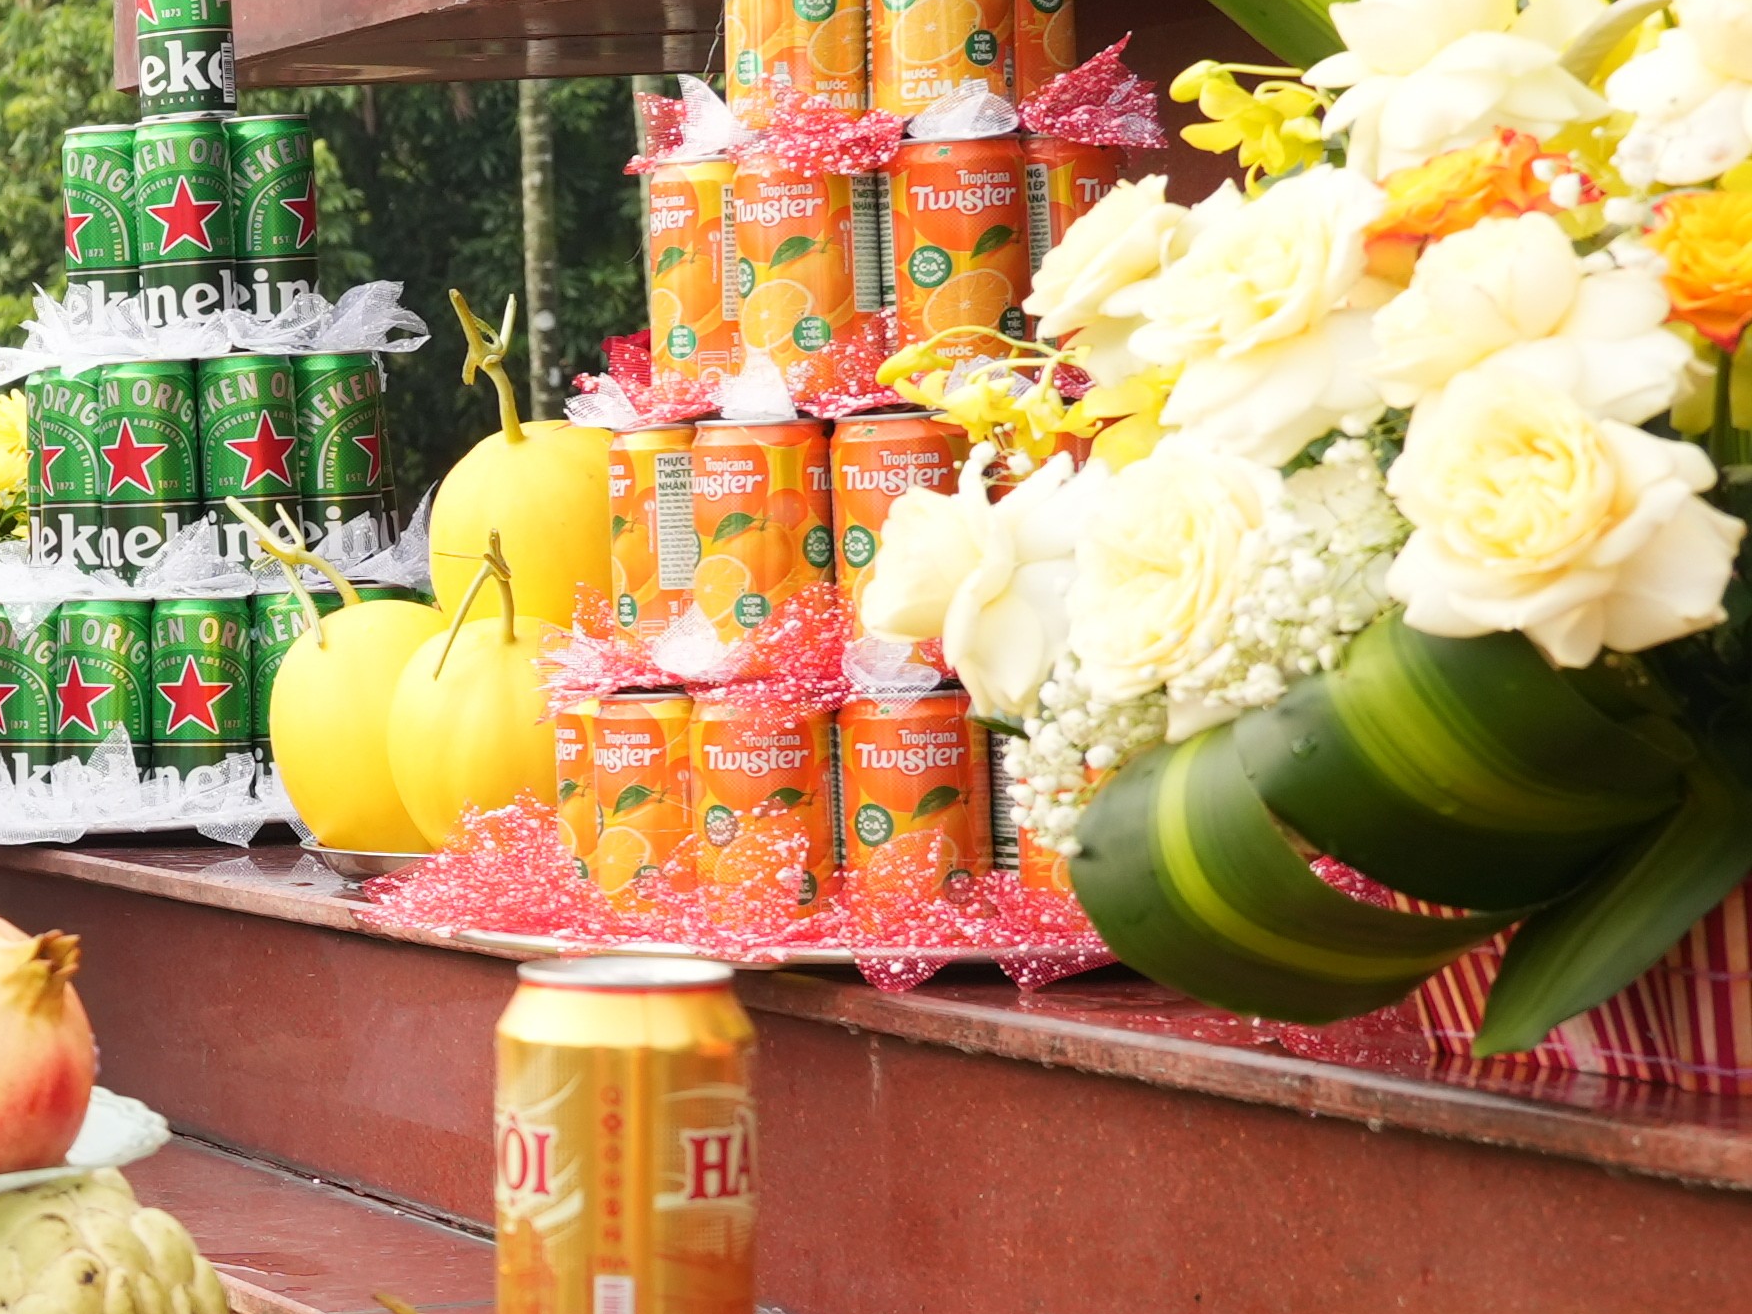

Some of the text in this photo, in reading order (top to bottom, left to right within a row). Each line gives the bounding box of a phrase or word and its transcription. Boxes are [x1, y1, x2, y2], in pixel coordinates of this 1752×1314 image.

[902, 67, 937, 79] NƯỚC
[956, 170, 1010, 186] Tropicana
[757, 183, 813, 198] Tropicana
[910, 185, 1016, 215] Twister
[734, 196, 824, 226] Twister
[936, 345, 973, 357] NƯỚC
[704, 456, 753, 472] Tropicana
[879, 450, 940, 466] Tropicana
[326, 445, 339, 489] DIPLOME
[841, 465, 950, 496] Twister
[603, 729, 651, 744] Tropicana
[742, 731, 801, 746] Tropicana
[898, 729, 958, 745] Tropicana
[703, 743, 810, 777] Twister
[855, 743, 965, 775] Twister
[501, 1112, 551, 1206] ỘI
